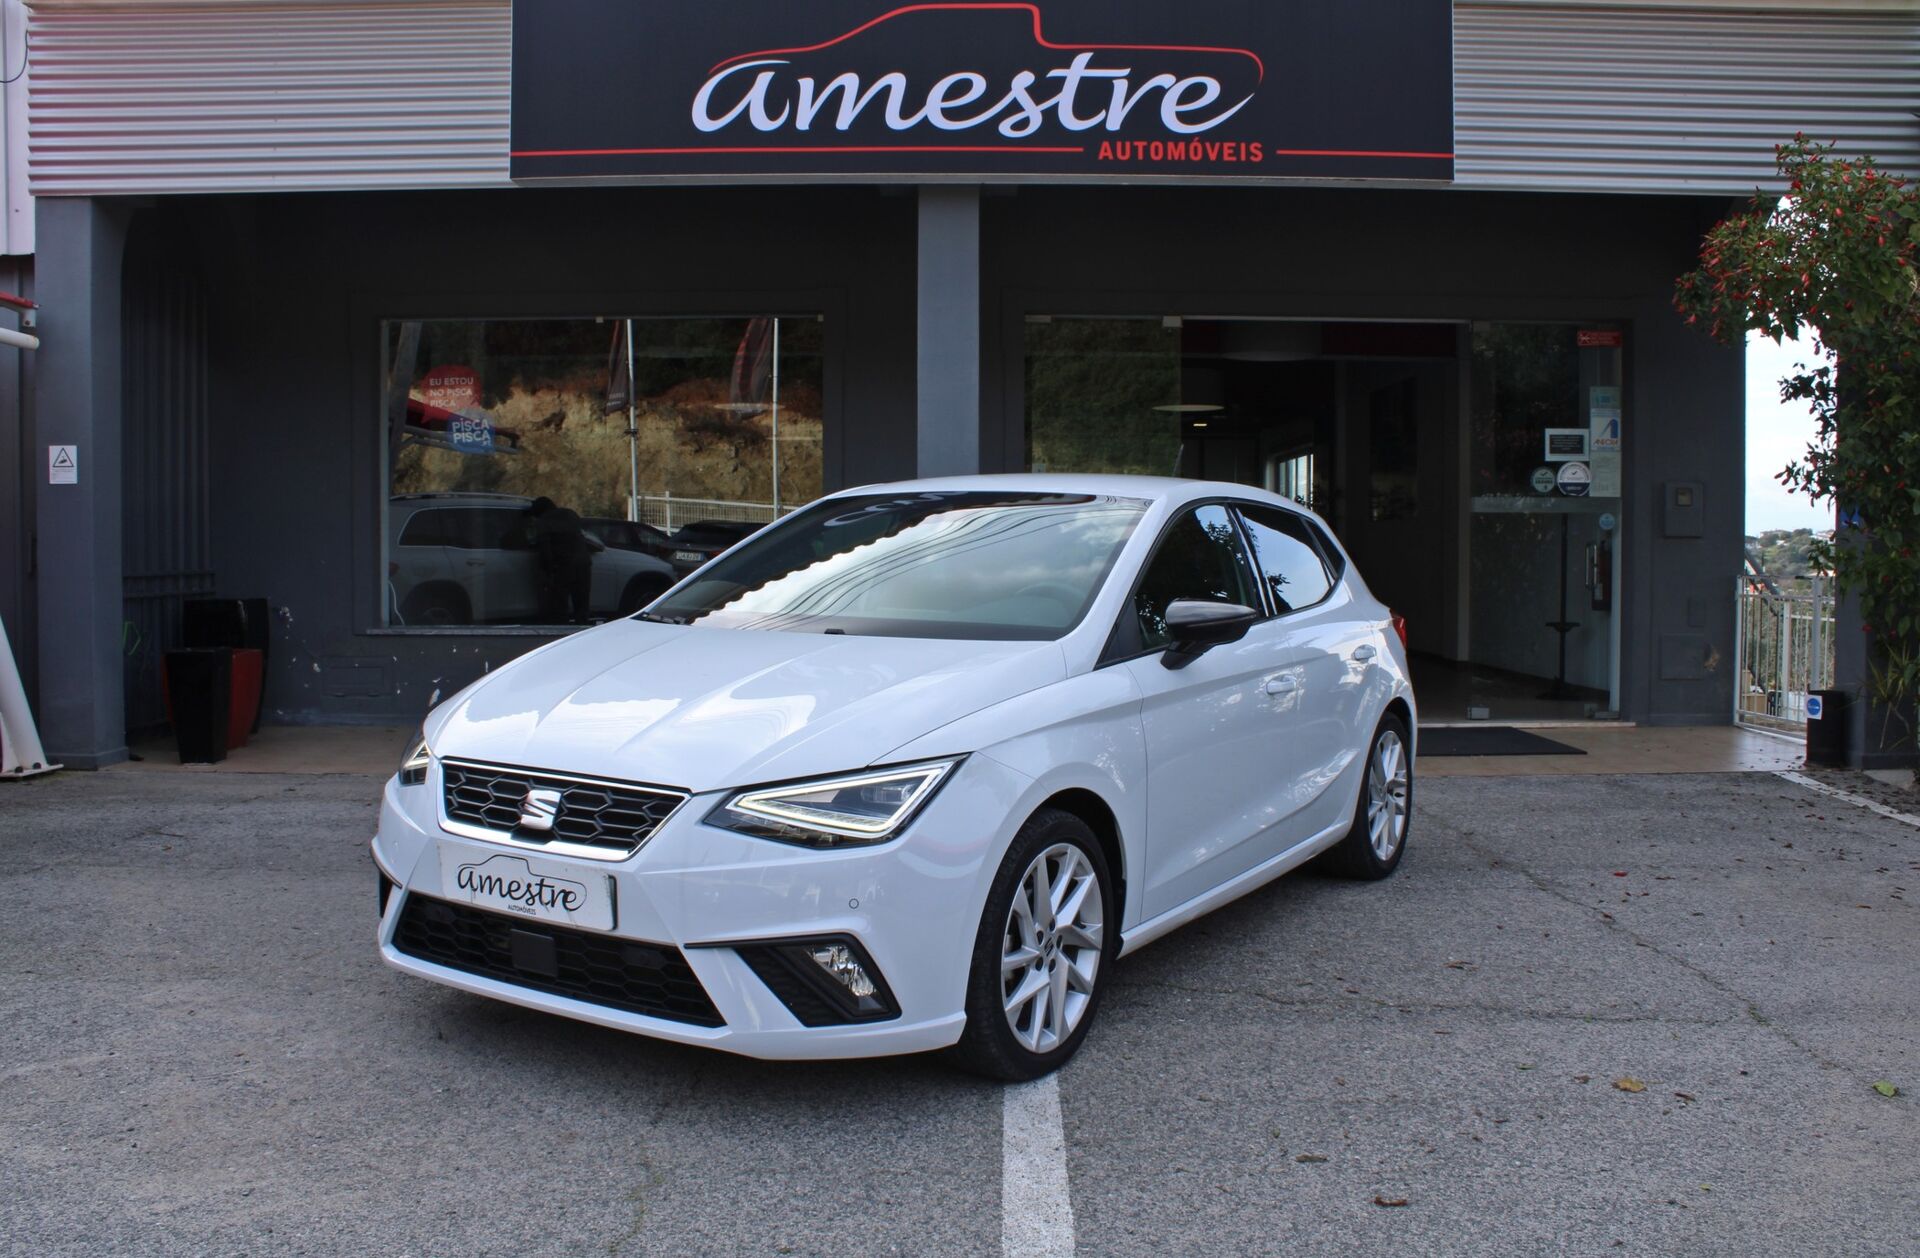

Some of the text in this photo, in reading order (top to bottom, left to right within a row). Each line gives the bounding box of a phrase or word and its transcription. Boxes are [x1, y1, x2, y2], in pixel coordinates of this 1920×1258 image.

[691, 51, 1255, 138] amestre
[1097, 138, 1263, 163] AUTOMÓVEIS
[429, 377, 474, 386] EU ESTOU
[429, 387, 473, 397] NO PISCA
[430, 399, 456, 408] PISCA
[457, 866, 584, 911] amestre
